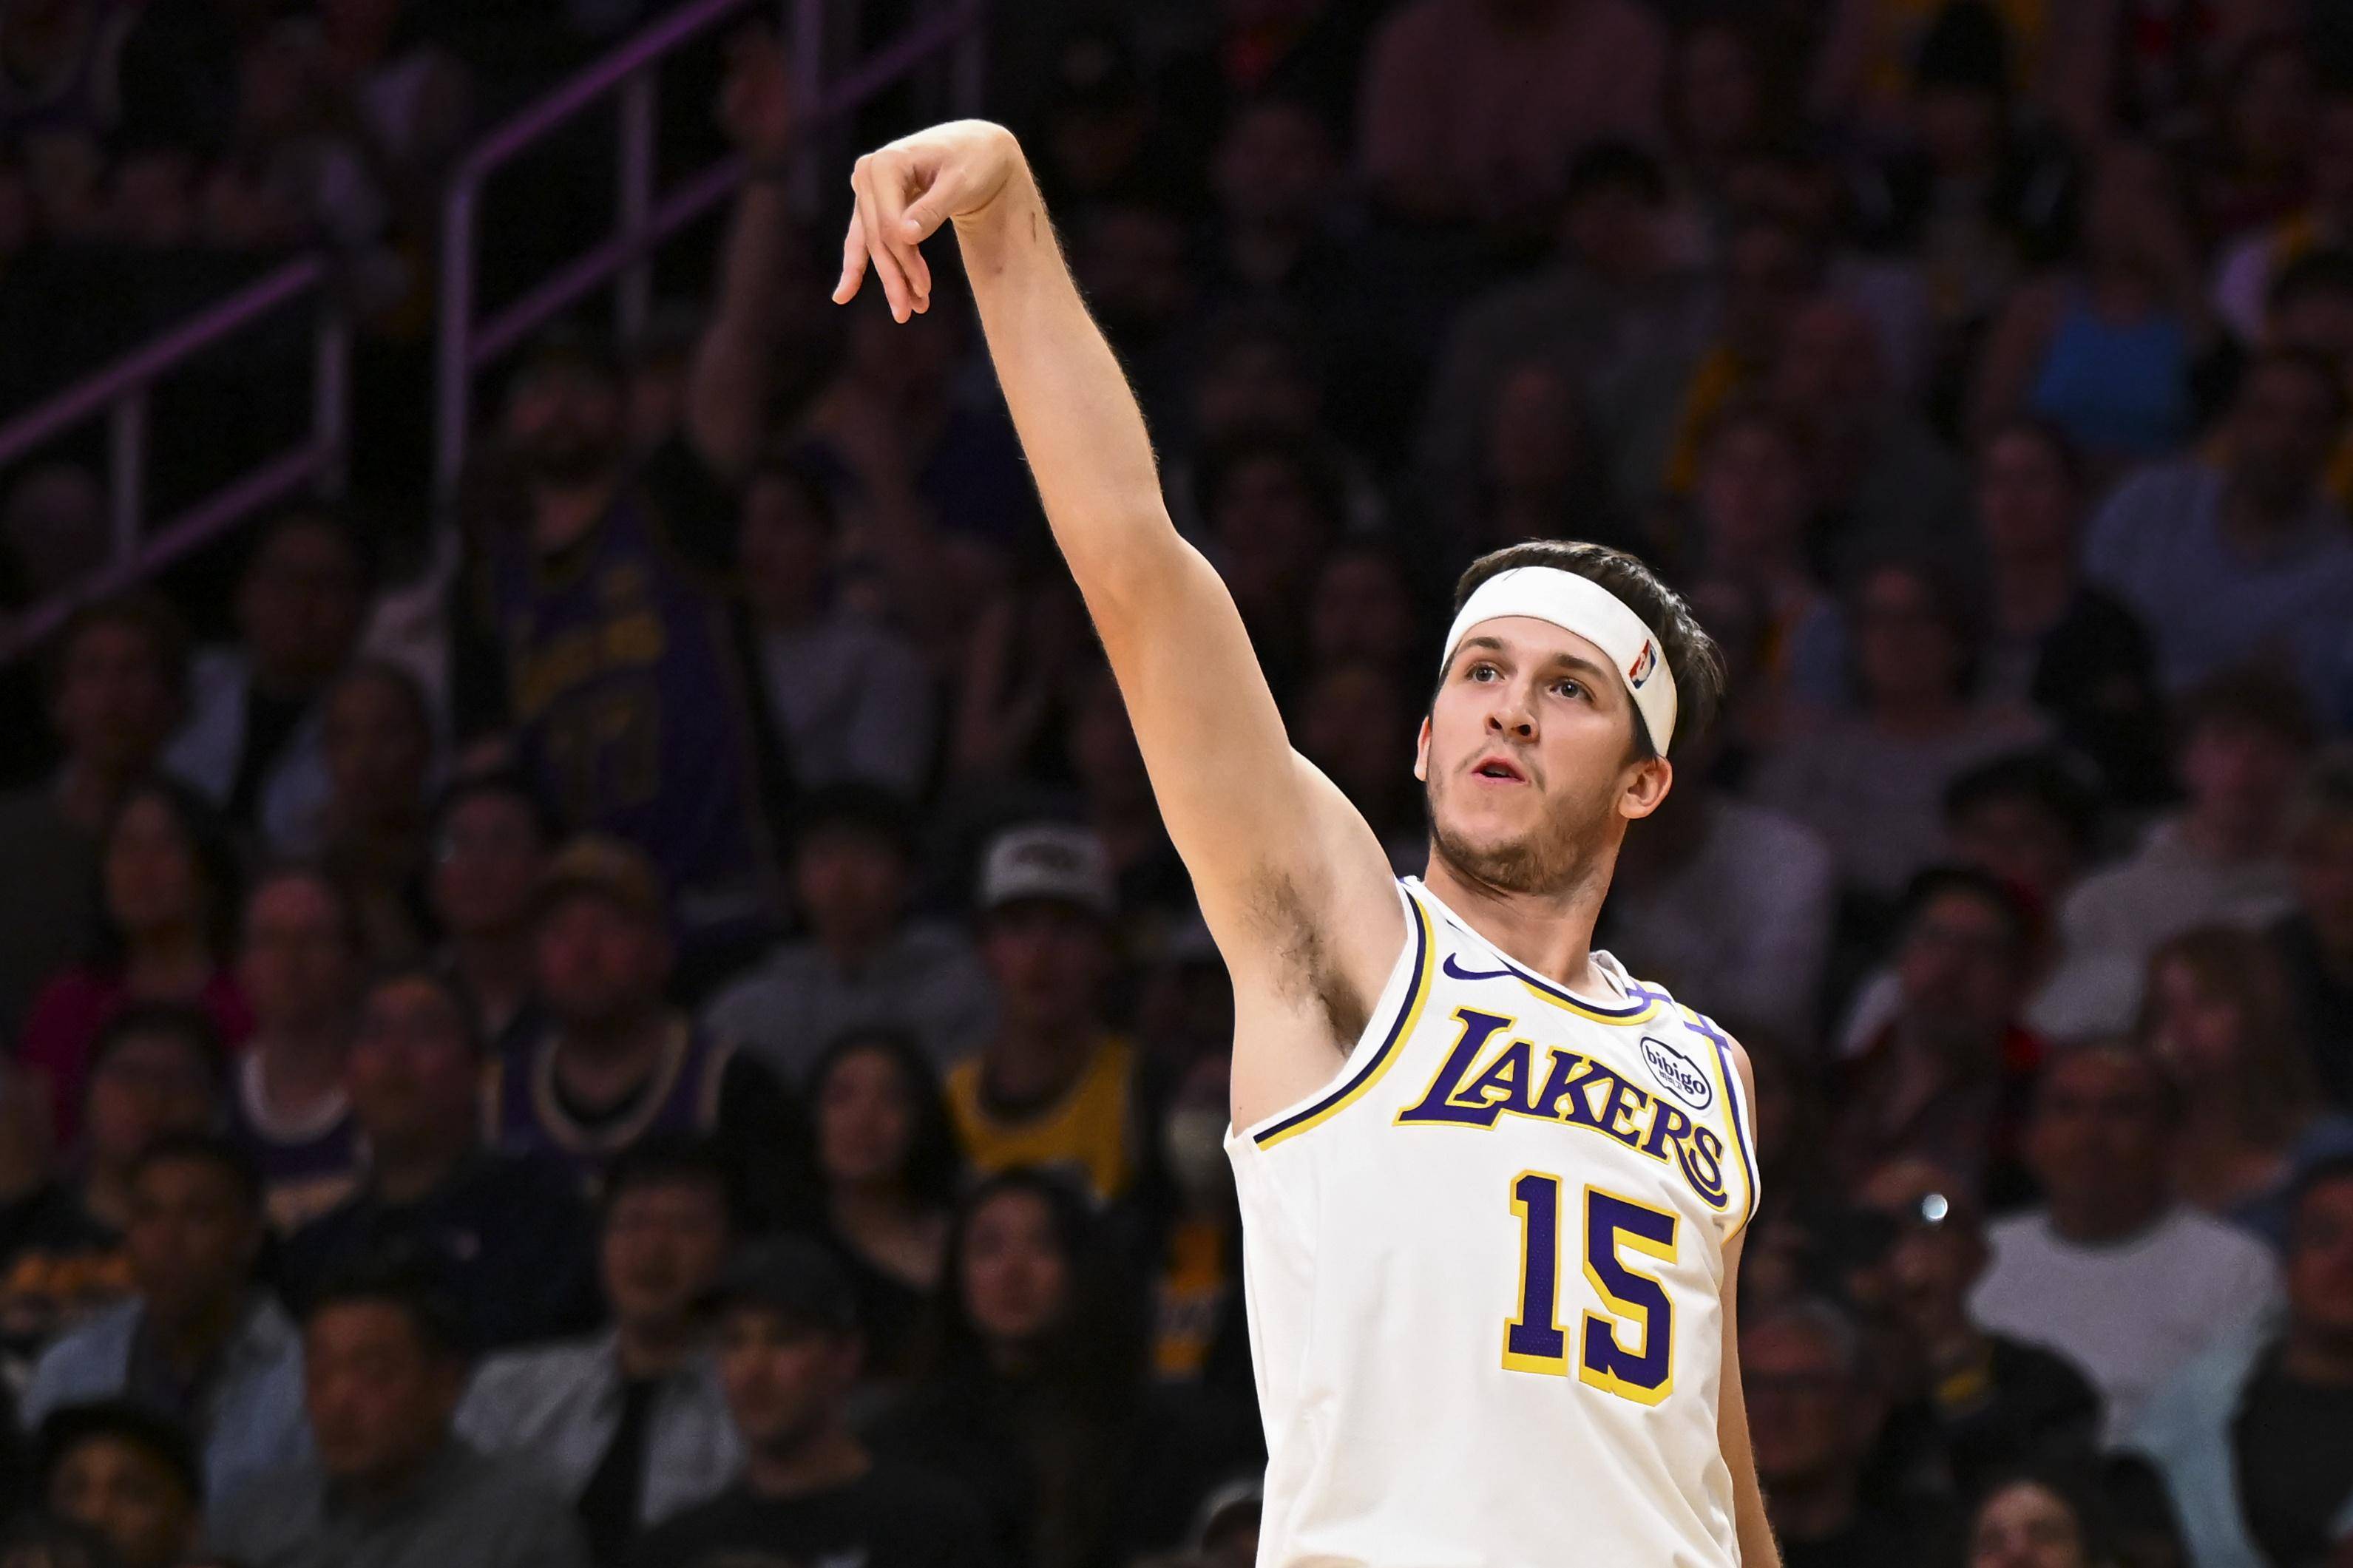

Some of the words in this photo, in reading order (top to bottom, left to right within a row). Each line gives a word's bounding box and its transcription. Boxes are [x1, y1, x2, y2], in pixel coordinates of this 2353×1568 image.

[1393, 1006, 1728, 1211] LAKERS
[1645, 1045, 1706, 1094] bibigo
[1502, 1170, 1681, 1405] 15
